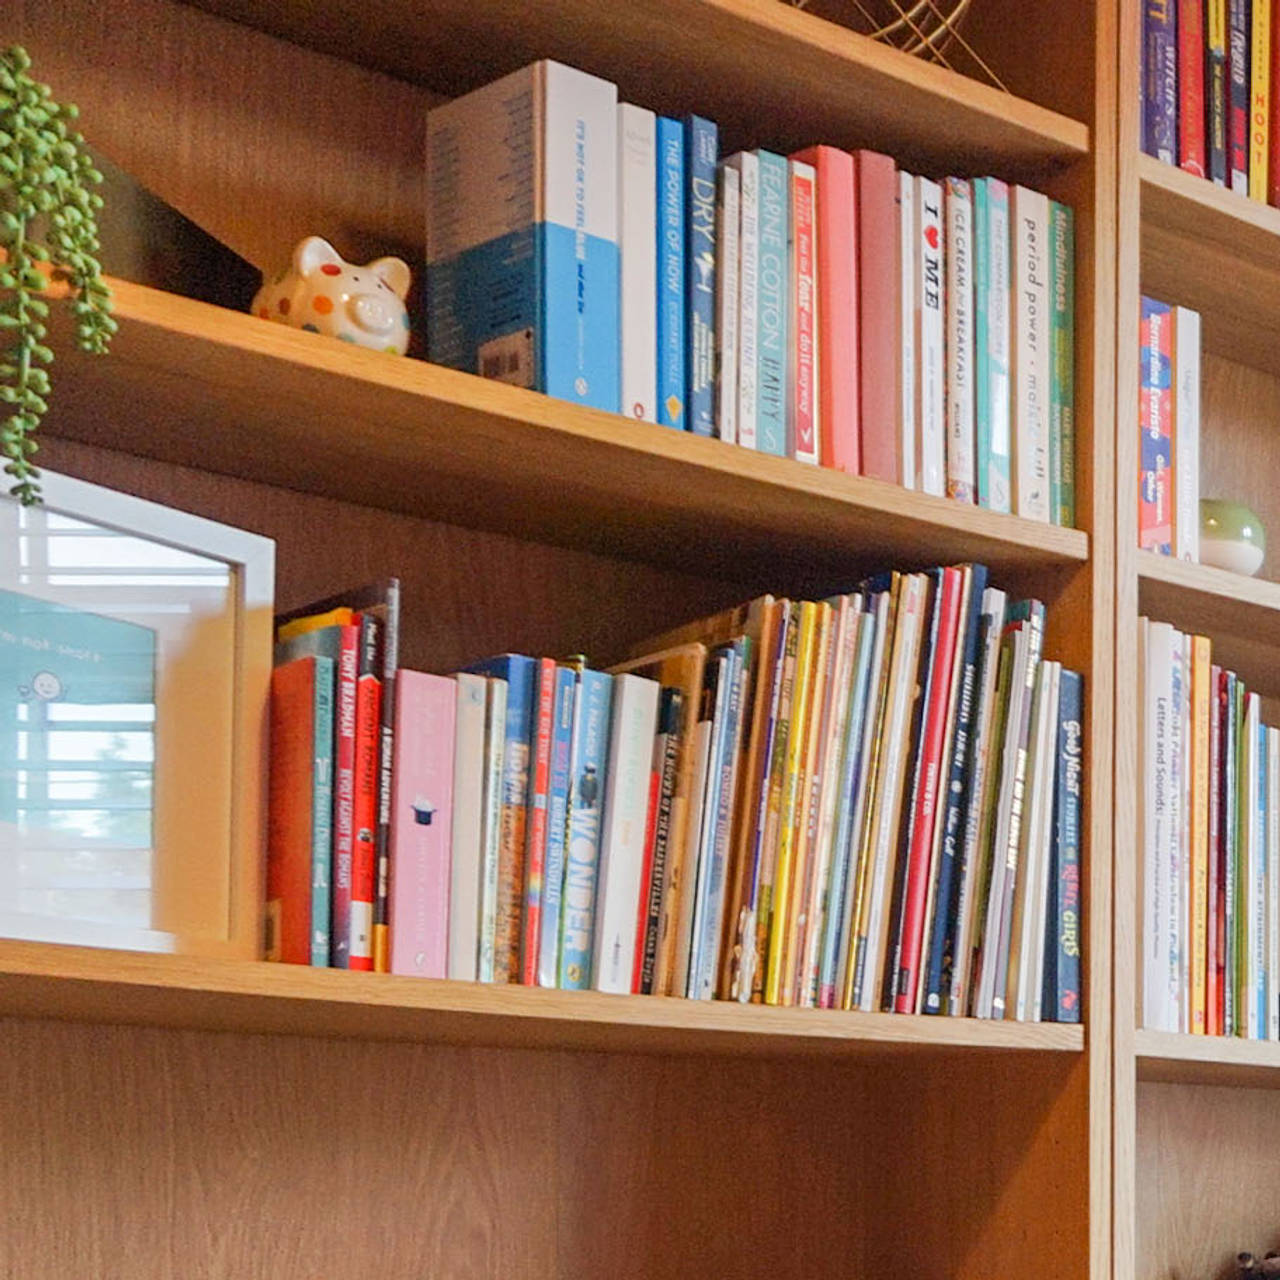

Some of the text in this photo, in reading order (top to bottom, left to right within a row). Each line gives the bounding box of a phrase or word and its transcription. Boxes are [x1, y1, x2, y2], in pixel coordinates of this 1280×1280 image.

[667, 140, 680, 293] THE POWER OF NOW
[692, 177, 716, 243] DRY
[761, 161, 783, 422] FEARNE COTTON HAPPY
[1023, 218, 1044, 352] period power
[1054, 211, 1068, 313] Mindfulness
[1150, 386, 1160, 440] Evaristo
[341, 648, 355, 737] TONY BRADMAN
[1153, 697, 1167, 733] Letters
[1154, 737, 1166, 764] and
[545, 796, 564, 904] ROBERT SWINDELLS
[566, 807, 601, 952] WONDER
